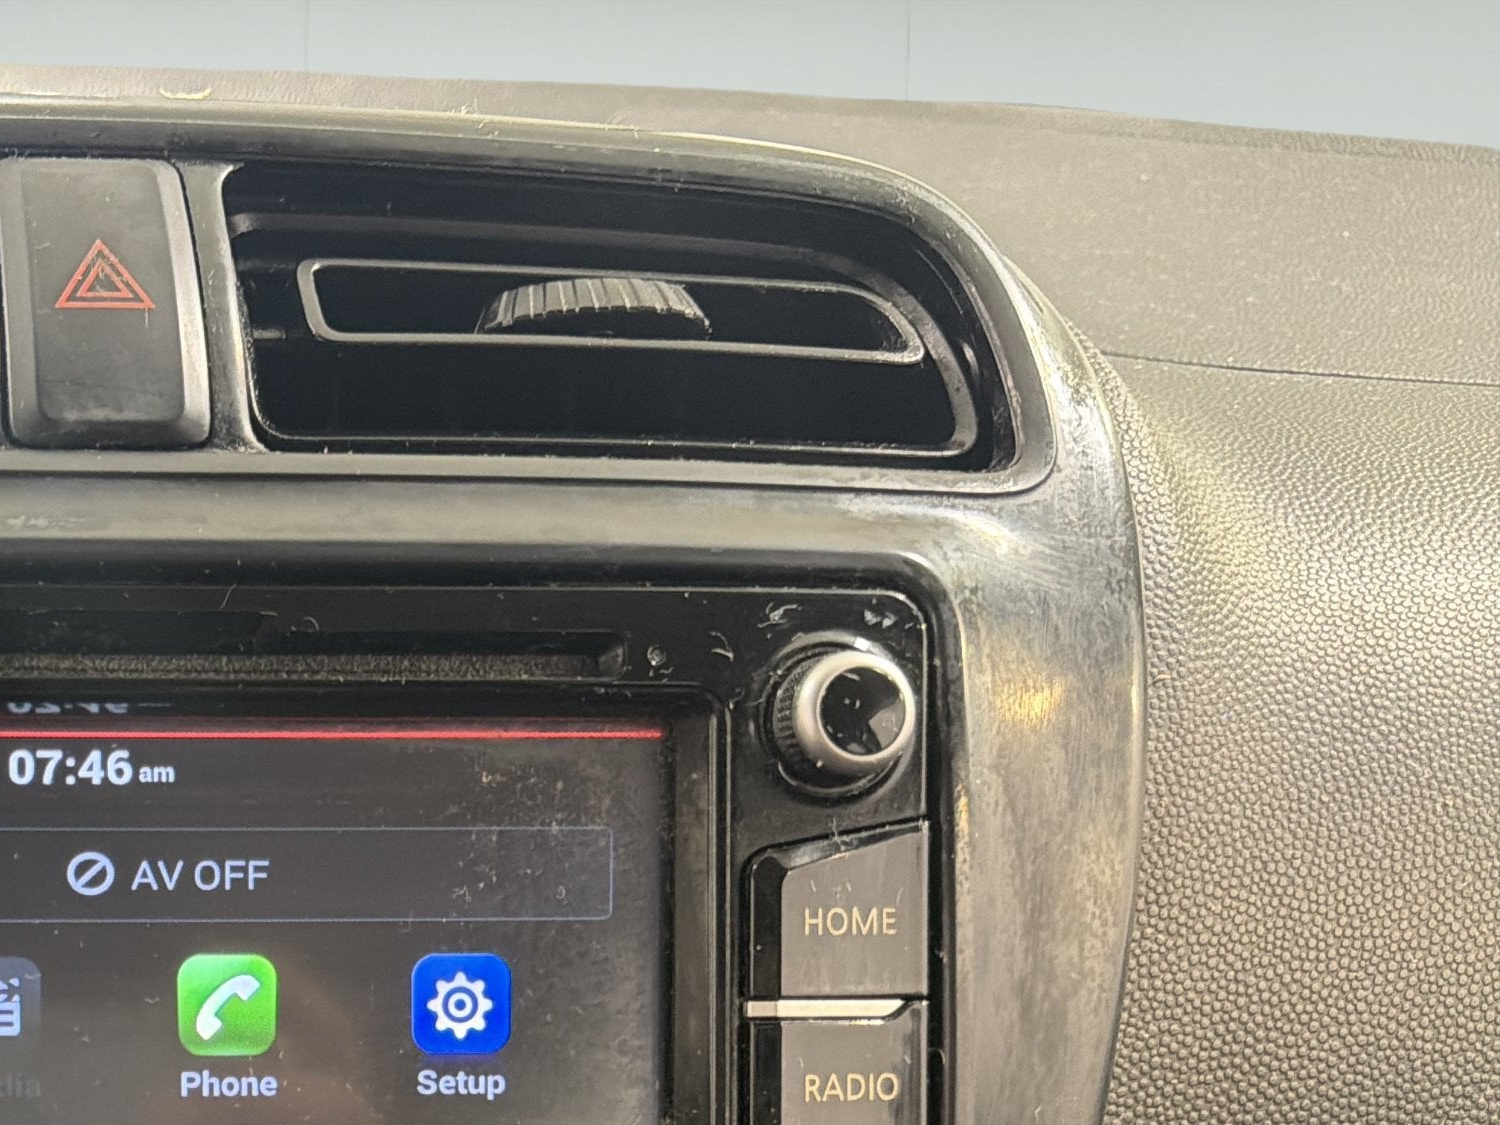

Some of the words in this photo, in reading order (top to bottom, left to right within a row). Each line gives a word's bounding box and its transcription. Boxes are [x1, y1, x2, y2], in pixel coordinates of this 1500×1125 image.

[8, 749, 133, 785] 07:46
[138, 766, 175, 783] am
[131, 859, 184, 891] AV
[194, 859, 270, 891] OFF
[804, 906, 897, 936] HOME
[180, 1070, 278, 1098] Phone
[417, 1069, 506, 1101] Setup
[805, 1072, 899, 1102] RADIO
